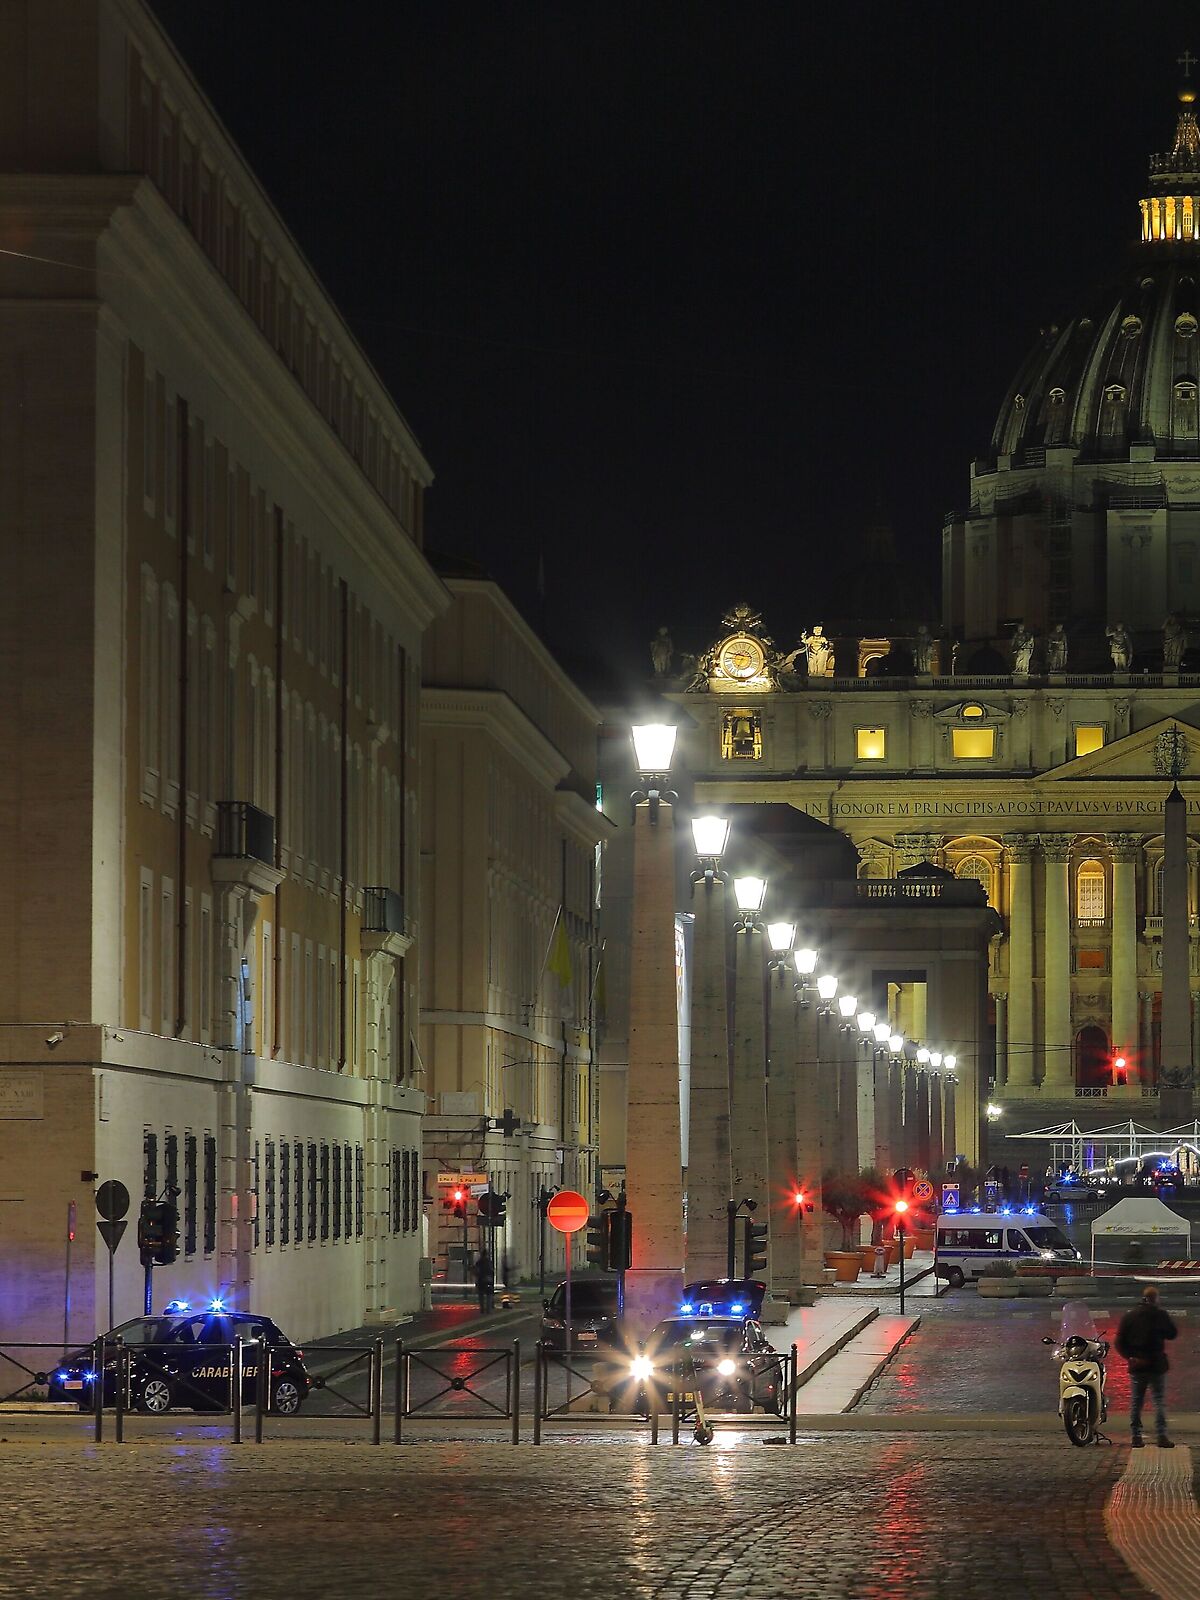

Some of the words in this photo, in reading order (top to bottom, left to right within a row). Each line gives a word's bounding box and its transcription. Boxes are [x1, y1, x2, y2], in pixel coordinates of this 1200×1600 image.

[805, 802, 823, 815] IN
[831, 802, 910, 814] HONOREM
[914, 802, 993, 814] PRINCIPIS
[996, 801, 1045, 813] APOST
[1046, 801, 1099, 813] PAVLVS
[1102, 801, 1112, 812] V
